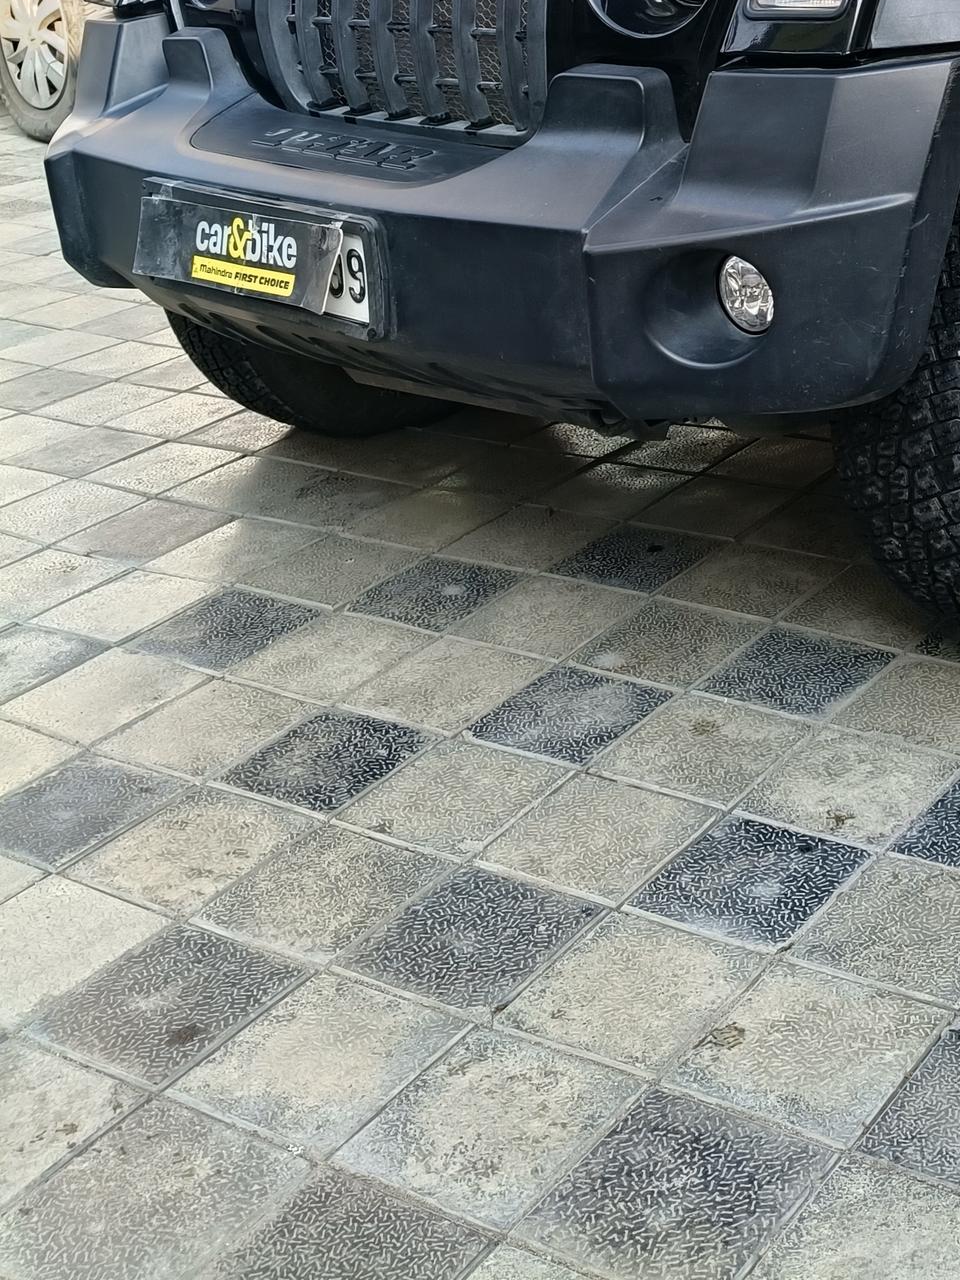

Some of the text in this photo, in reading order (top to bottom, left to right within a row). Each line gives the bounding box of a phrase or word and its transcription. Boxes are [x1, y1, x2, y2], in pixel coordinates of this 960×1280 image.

[195, 217, 298, 269] car&bike
[199, 263, 291, 291] Mahindra FIRST CHOICE
